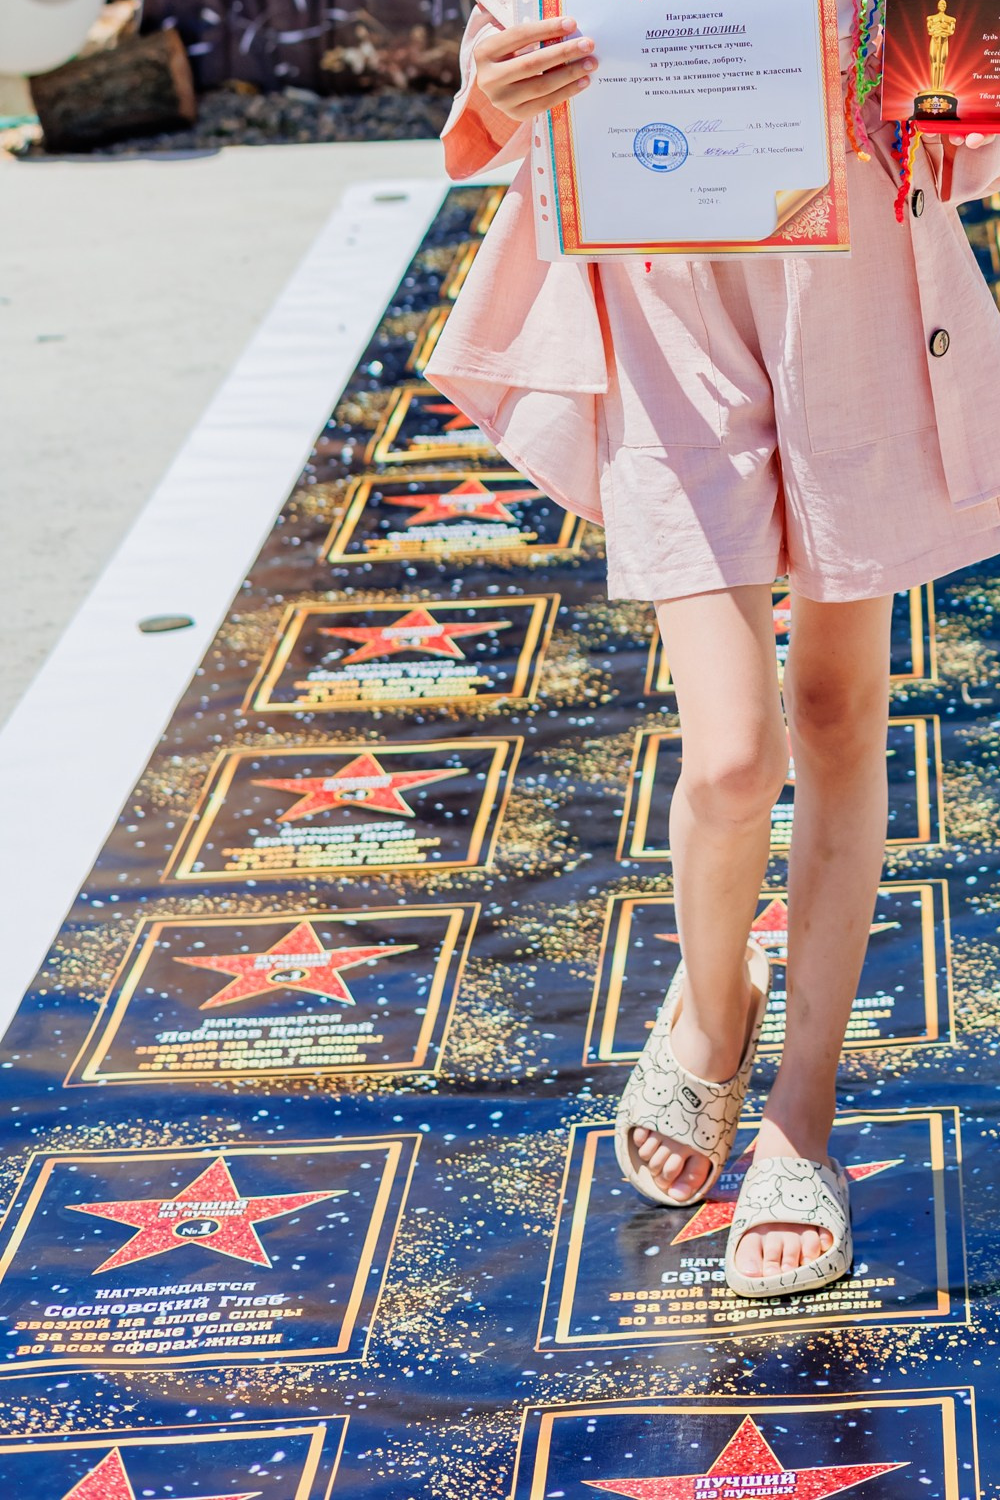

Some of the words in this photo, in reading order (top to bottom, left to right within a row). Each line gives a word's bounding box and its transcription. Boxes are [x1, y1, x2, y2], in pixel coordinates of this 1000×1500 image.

[666, 11, 724, 22] Награждается
[645, 28, 700, 39] МОРОЗОВА
[702, 24, 747, 36] ПОЛИНА
[651, 44, 688, 54] старание
[689, 42, 722, 53] учиться
[724, 40, 753, 50] лучше,
[660, 58, 710, 69] трудолюбие,
[598, 76, 627, 85] умение
[683, 71, 720, 81] активное
[722, 70, 753, 79] участие
[763, 66, 802, 76] классных
[652, 87, 695, 96] школьных
[697, 84, 757, 95] мероприятиях.
[697, 185, 727, 193] Армавир
[160, 1200, 249, 1211] ЛУЧШИЙ
[158, 1210, 178, 1218] из
[182, 1209, 244, 1218] лучших
[95, 1282, 256, 1299] НАГРАЖДАЕТСЯ
[609, 1287, 704, 1301] звездой
[711, 1287, 736, 1297] на
[44, 1295, 209, 1318] Сосновский
[217, 1294, 285, 1308] Глеб
[634, 1303, 660, 1313] за
[669, 1297, 781, 1312] звездные
[790, 1290, 869, 1306] успехи
[14, 1318, 110, 1331] звездой
[117, 1317, 145, 1328] на
[153, 1311, 221, 1326] аллее
[229, 1308, 303, 1320] славы
[619, 1315, 646, 1326] во
[654, 1314, 707, 1325] всех
[714, 1308, 798, 1323] сферах
[805, 1300, 882, 1313] жизни
[35, 1331, 62, 1341] за
[70, 1326, 184, 1341] звездные
[192, 1320, 273, 1337] успехи
[17, 1345, 44, 1355] во
[52, 1343, 105, 1353] всех
[112, 1339, 198, 1355] сферах
[202, 1333, 283, 1347] жизни
[695, 1472, 796, 1489] ЛУЧШИЙ
[695, 1490, 718, 1499] из
[723, 1485, 794, 1498] лучших
